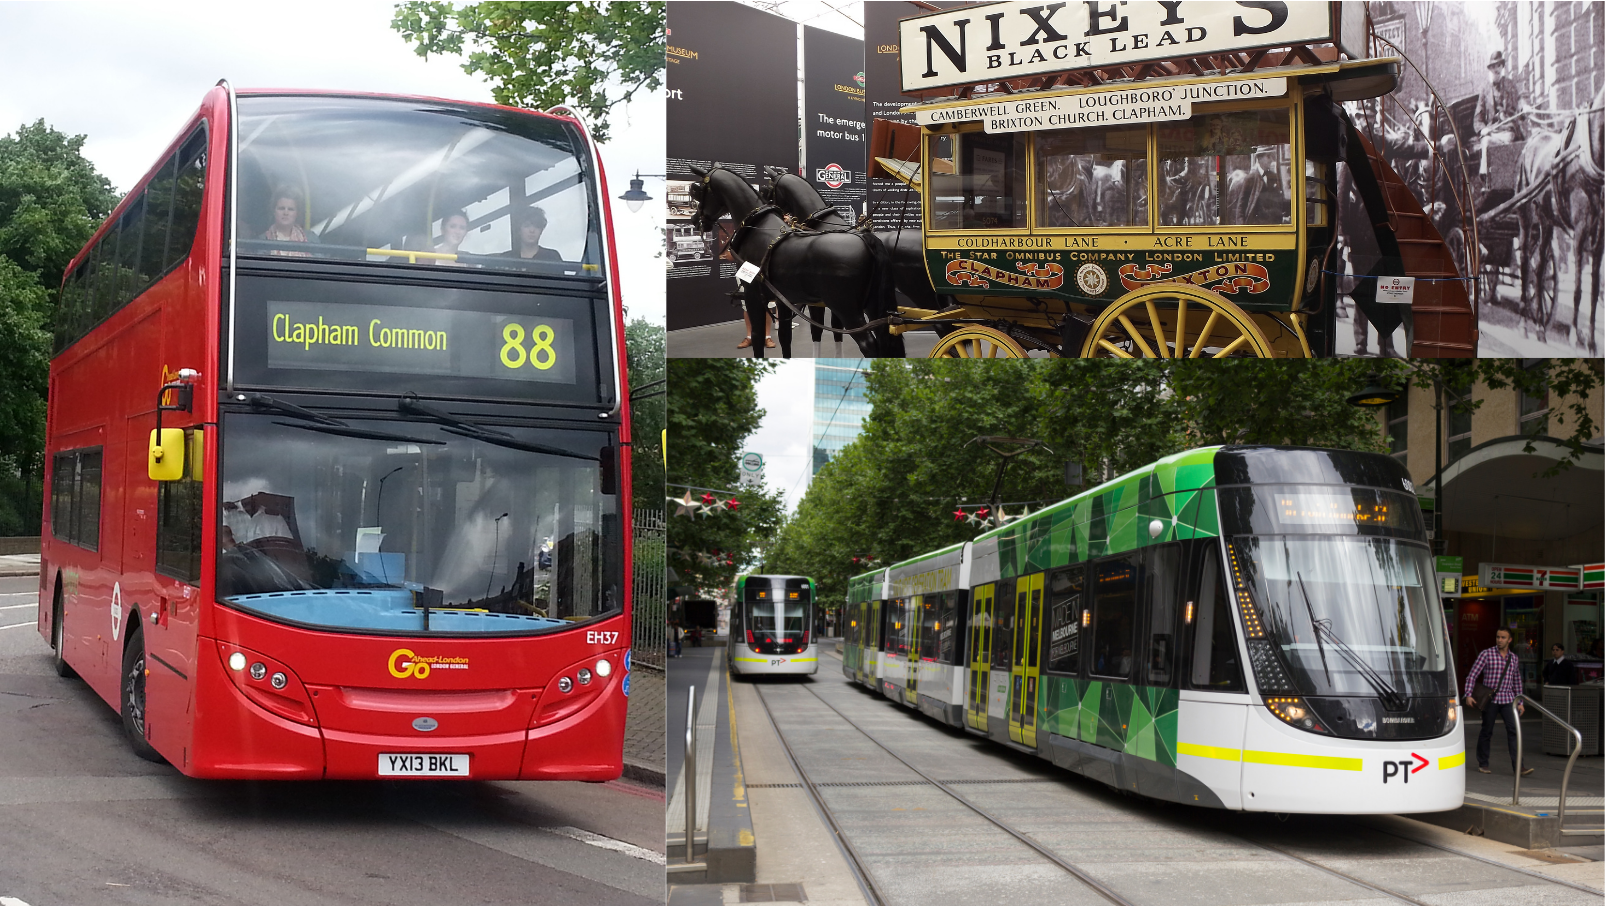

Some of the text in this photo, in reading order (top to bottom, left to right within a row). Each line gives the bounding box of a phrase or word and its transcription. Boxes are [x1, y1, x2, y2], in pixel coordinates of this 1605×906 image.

[666, 45, 698, 60] MUSEUM
[877, 44, 899, 54] LOND
[986, 26, 1207, 69] BLACK LEAD
[834, 84, 856, 93] LONDON
[931, 105, 1009, 122] CAMBERWELL
[1015, 100, 1060, 114] GREEN.
[1180, 82, 1268, 99] JUNCTION.
[818, 113, 866, 130] The emerge
[991, 105, 1186, 130] BRIXTON CHURCH. CLAPHAM.
[817, 130, 842, 140] motor
[845, 132, 859, 141] bus
[817, 170, 850, 182] GENERAL
[957, 237, 1099, 248] COLDHARBOUR LANE
[1153, 236, 1248, 248] ACRE LANE
[941, 251, 1275, 262] THE STAR OMNIBUS COMPANY LONDON LIMITED
[958, 260, 1051, 288] CLAPHAM
[272, 313, 556, 370] Clapham Common 88
[742, 471, 760, 479] ONLY
[1491, 571, 1502, 580] 24
[1461, 579, 1479, 588] WESTE
[1461, 613, 1479, 621] ATM
[587, 631, 619, 645] EH37
[1052, 622, 1078, 641] MELBOURNE
[388, 648, 430, 679] Go
[389, 755, 459, 772] YX13 BKL
[1383, 760, 1414, 784] PT
